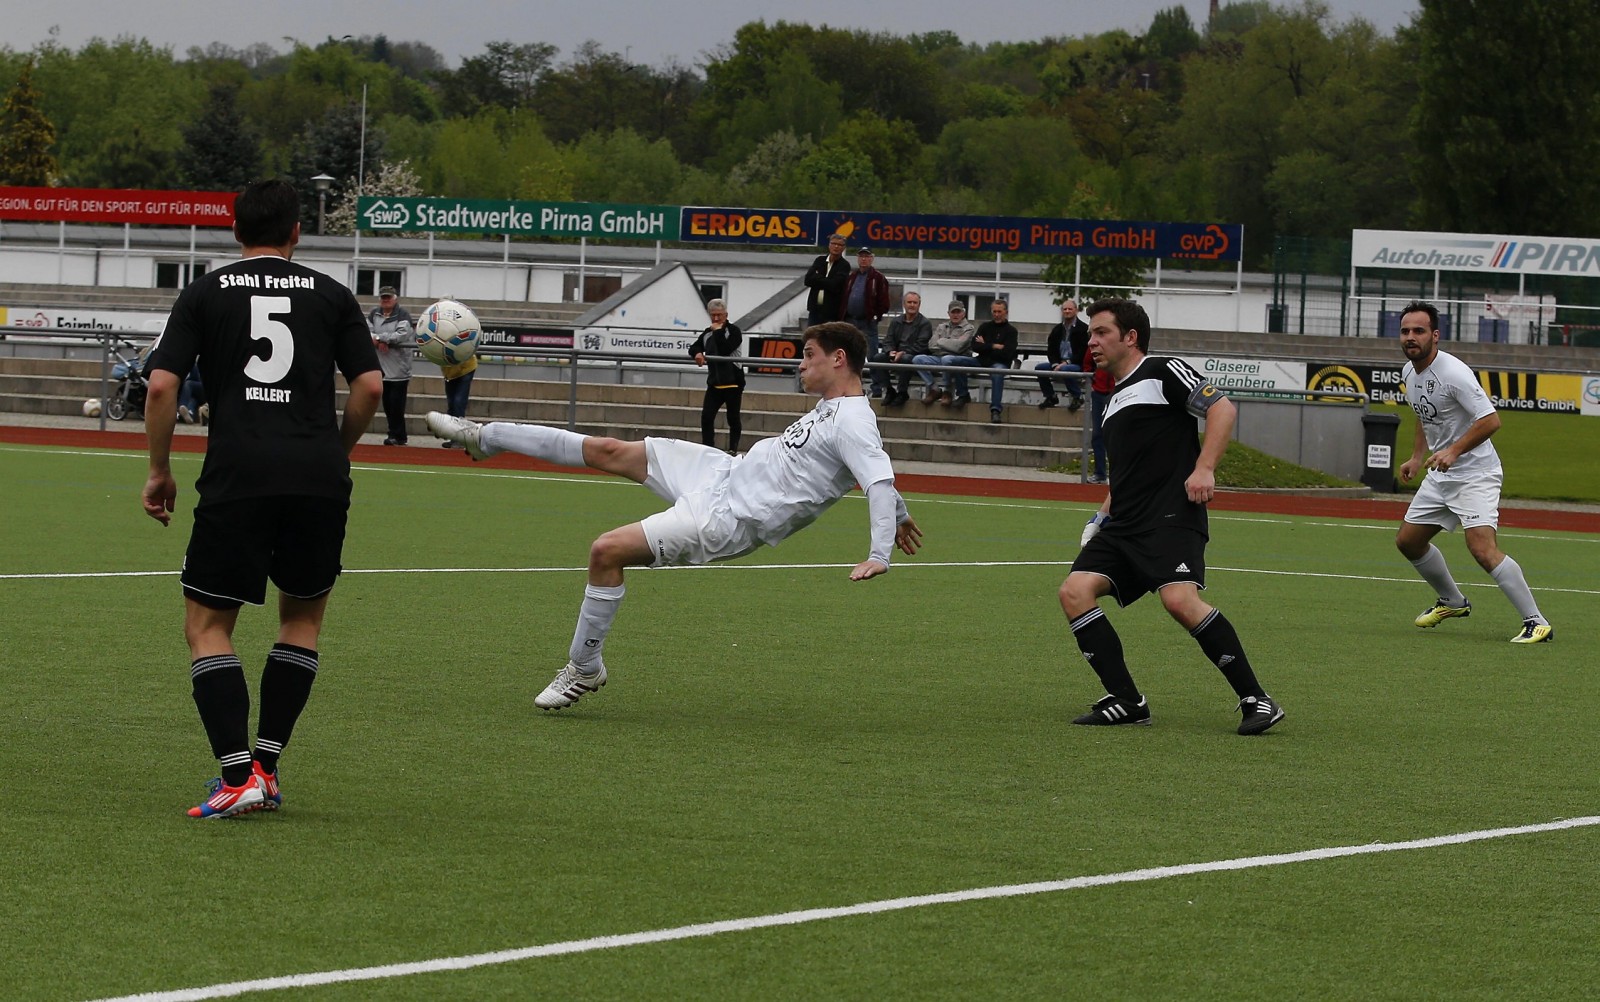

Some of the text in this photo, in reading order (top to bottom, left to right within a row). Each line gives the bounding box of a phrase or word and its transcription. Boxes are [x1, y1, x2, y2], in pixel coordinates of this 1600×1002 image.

[34, 199, 56, 211] GUT
[58, 198, 78, 211] FÜR
[81, 201, 103, 212] DEN
[106, 201, 142, 213] SPORT.
[146, 202, 168, 214] GUT
[170, 200, 190, 214] FÜR
[194, 202, 231, 216] PIRNA.
[375, 210, 402, 223] SWP
[416, 204, 664, 234] Stadtwerke Pirna GmbH
[690, 213, 808, 239] ERDGAS.
[867, 219, 1156, 251] Gasversorgung Pirna GmbH
[1180, 233, 1215, 251] GVP
[1371, 247, 1485, 268] Autohaus
[219, 273, 315, 290] Stahl Freital
[243, 295, 295, 384] 5
[611, 338, 691, 350] Unterstützen Sie
[1204, 358, 1261, 374] Glaserei
[245, 387, 292, 403] KELLERT
[1491, 395, 1575, 411] Service GmbH
